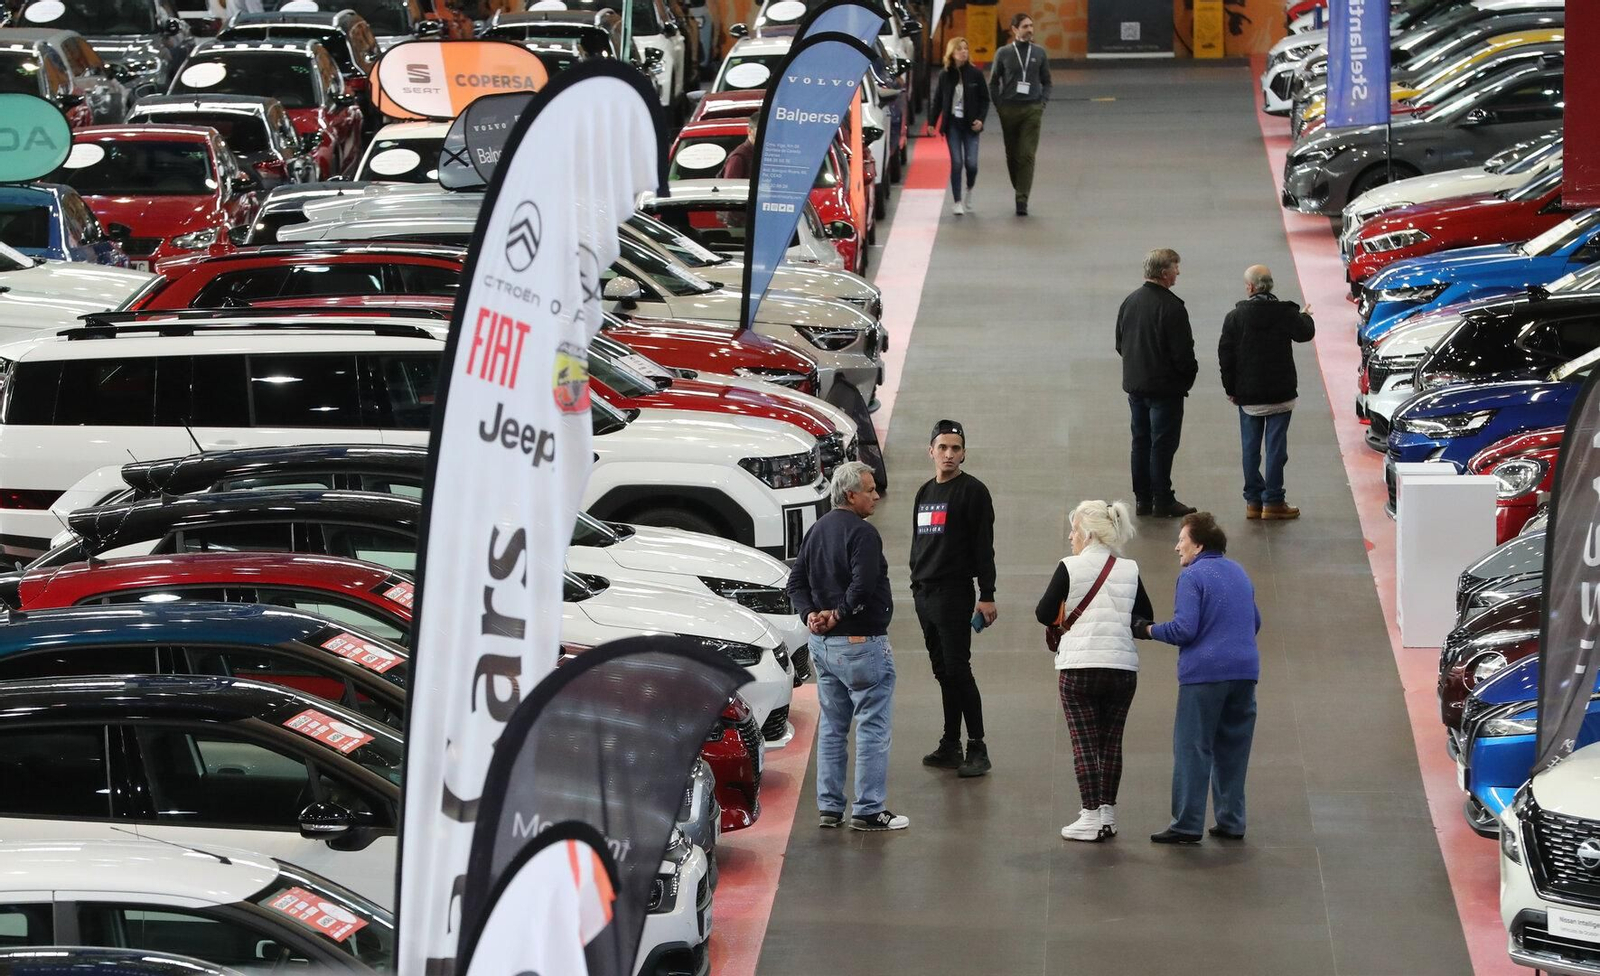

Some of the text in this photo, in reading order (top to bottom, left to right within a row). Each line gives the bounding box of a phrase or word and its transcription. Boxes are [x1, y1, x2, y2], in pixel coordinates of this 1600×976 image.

[455, 74, 535, 89] COPERSA
[787, 76, 855, 87] VOLVO
[775, 107, 840, 124] Balpersa
[473, 123, 507, 132] VOLVO
[466, 306, 531, 389] FIAT
[479, 402, 556, 468] Jeep
